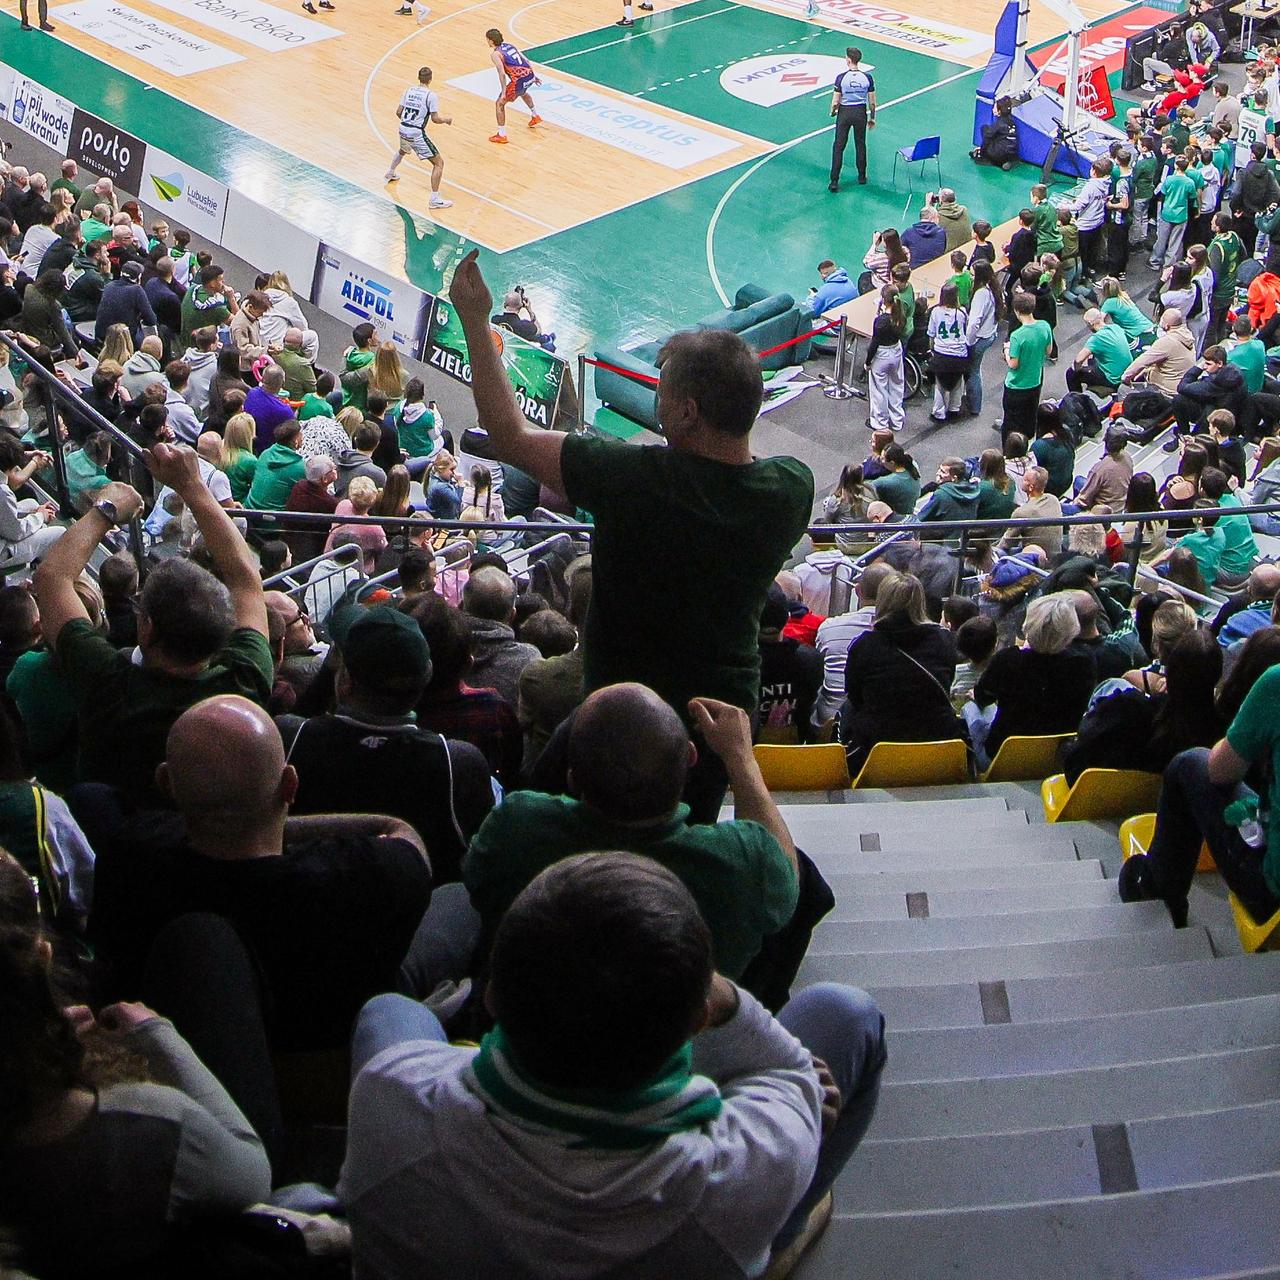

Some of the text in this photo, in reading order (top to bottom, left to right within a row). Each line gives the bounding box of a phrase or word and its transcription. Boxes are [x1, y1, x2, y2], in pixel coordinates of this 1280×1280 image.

[240, 15, 306, 44] Pekao
[732, 56, 809, 85] SUZUKI
[28, 92, 69, 140] pij wodę
[403, 106, 420, 121] 77
[550, 91, 701, 149] perceptus
[30, 116, 60, 147] kranu
[80, 126, 131, 166] posto
[1241, 126, 1257, 142] 79
[82, 154, 118, 180] DEVELOPMENT
[187, 184, 218, 211] Lubuskie
[340, 279, 395, 322] ARPOL
[938, 320, 961, 339] 44
[429, 345, 547, 425] ZIELO ÓRA
